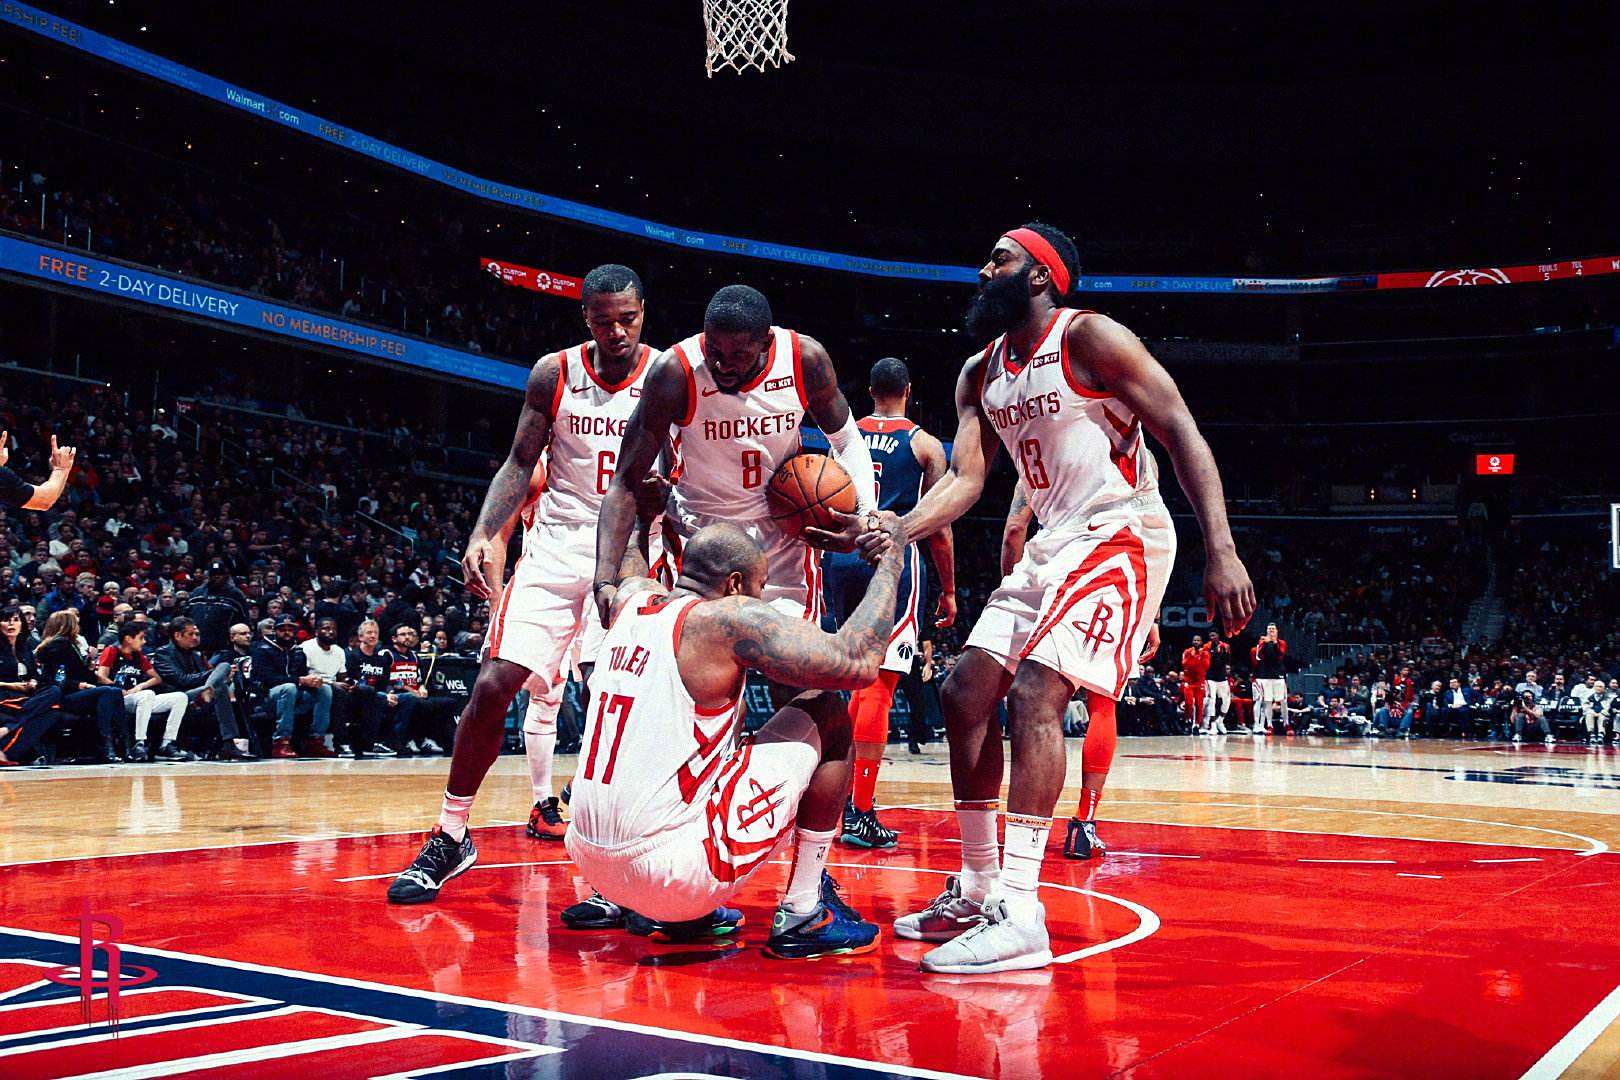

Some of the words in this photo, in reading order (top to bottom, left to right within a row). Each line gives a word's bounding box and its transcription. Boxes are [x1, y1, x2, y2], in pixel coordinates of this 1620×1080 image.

[225, 87, 266, 113] Walmart
[279, 109, 300, 126] com
[318, 123, 346, 142] FREE
[351, 134, 383, 155] 2-DAY
[382, 144, 432, 174] DELIVERY
[644, 224, 676, 242] Walmart
[685, 234, 705, 246] com
[503, 267, 527, 278] CUSTOM
[783, 248, 832, 266] DELIVERY
[38, 254, 88, 283] FREE
[98, 269, 155, 298] 2-DAY
[157, 283, 240, 318] DELIVERY
[552, 277, 576, 289] CUSTOM
[1093, 280, 1113, 289] com
[261, 310, 286, 329] NO
[289, 319, 378, 349] MEMBERSHIP
[380, 339, 407, 357] FEE!
[702, 411, 796, 441] ROCKETS
[986, 391, 1061, 431] ROCKETS
[596, 450, 616, 495] 6
[741, 449, 762, 490] 8
[1018, 438, 1050, 490] 13
[445, 679, 467, 691] WGL
[583, 691, 635, 785] 17
